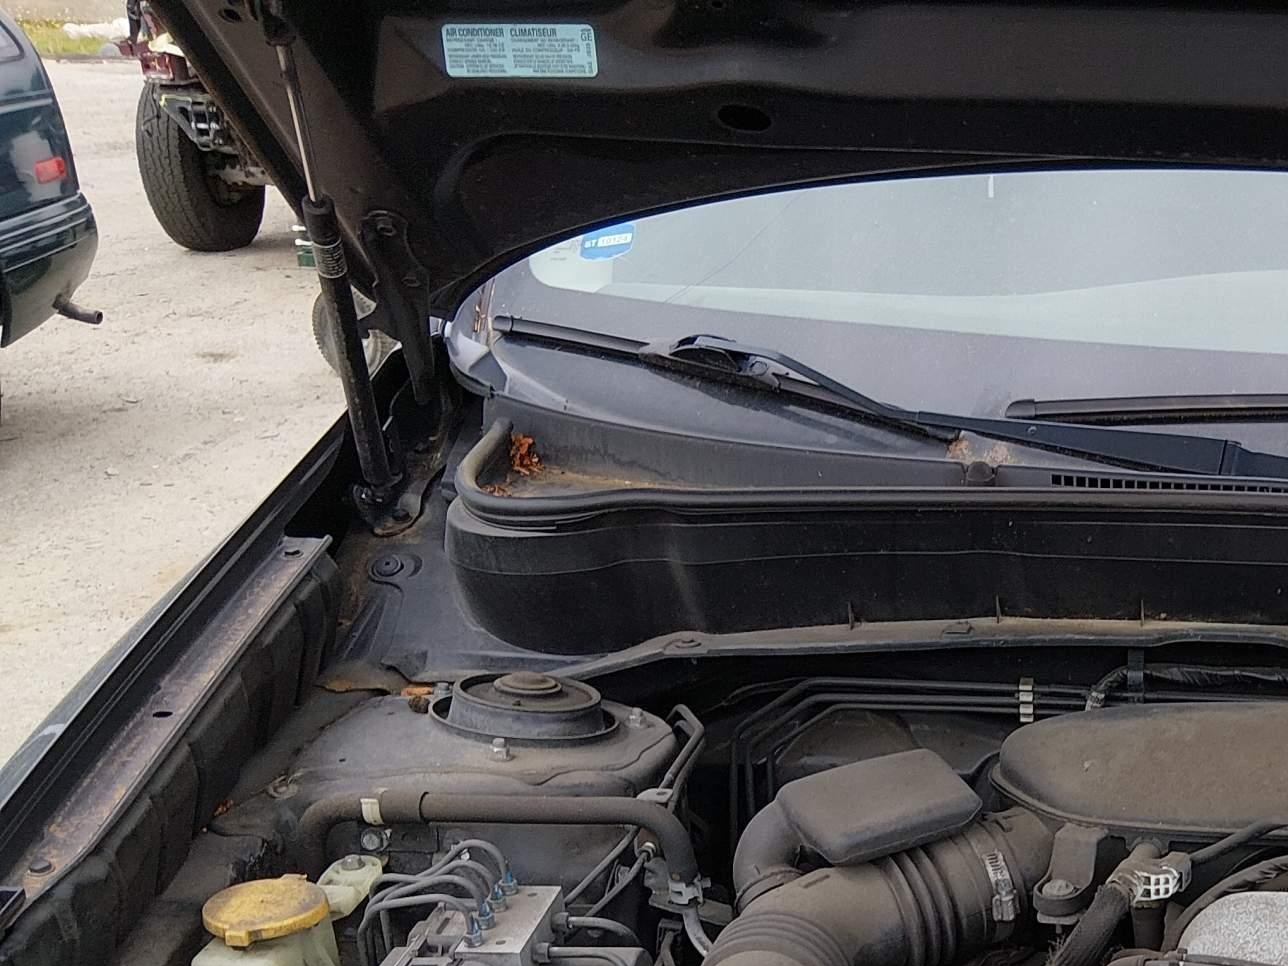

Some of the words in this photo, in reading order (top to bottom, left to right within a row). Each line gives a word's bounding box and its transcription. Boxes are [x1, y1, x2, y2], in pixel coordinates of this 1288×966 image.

[446, 28, 457, 37] AIR
[458, 28, 504, 38] CONDITIONER
[509, 28, 557, 38] CLIMATISEUR
